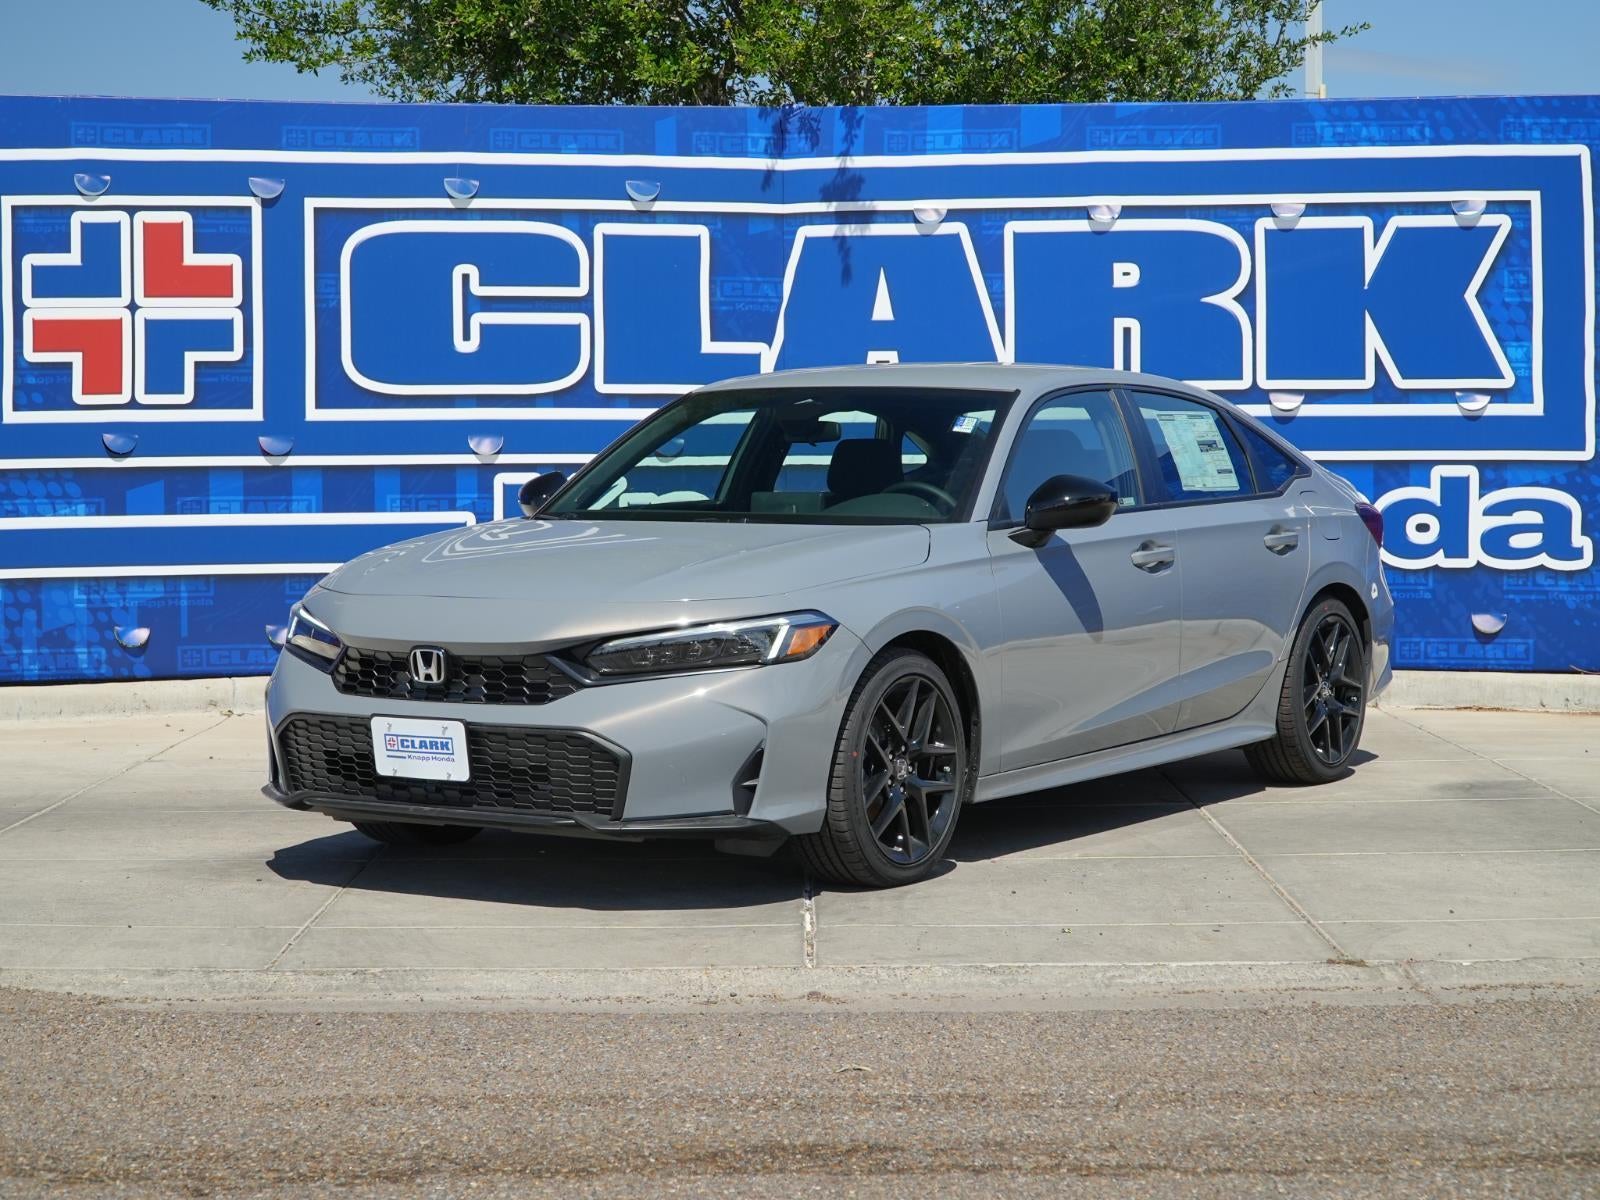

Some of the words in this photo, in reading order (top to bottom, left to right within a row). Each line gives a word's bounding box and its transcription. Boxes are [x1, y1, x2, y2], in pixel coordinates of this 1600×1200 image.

[340, 213, 1516, 396] CLARK
[400, 738, 451, 752] CLARK
[407, 754, 431, 763] Knapp
[431, 755, 455, 763] Honda
